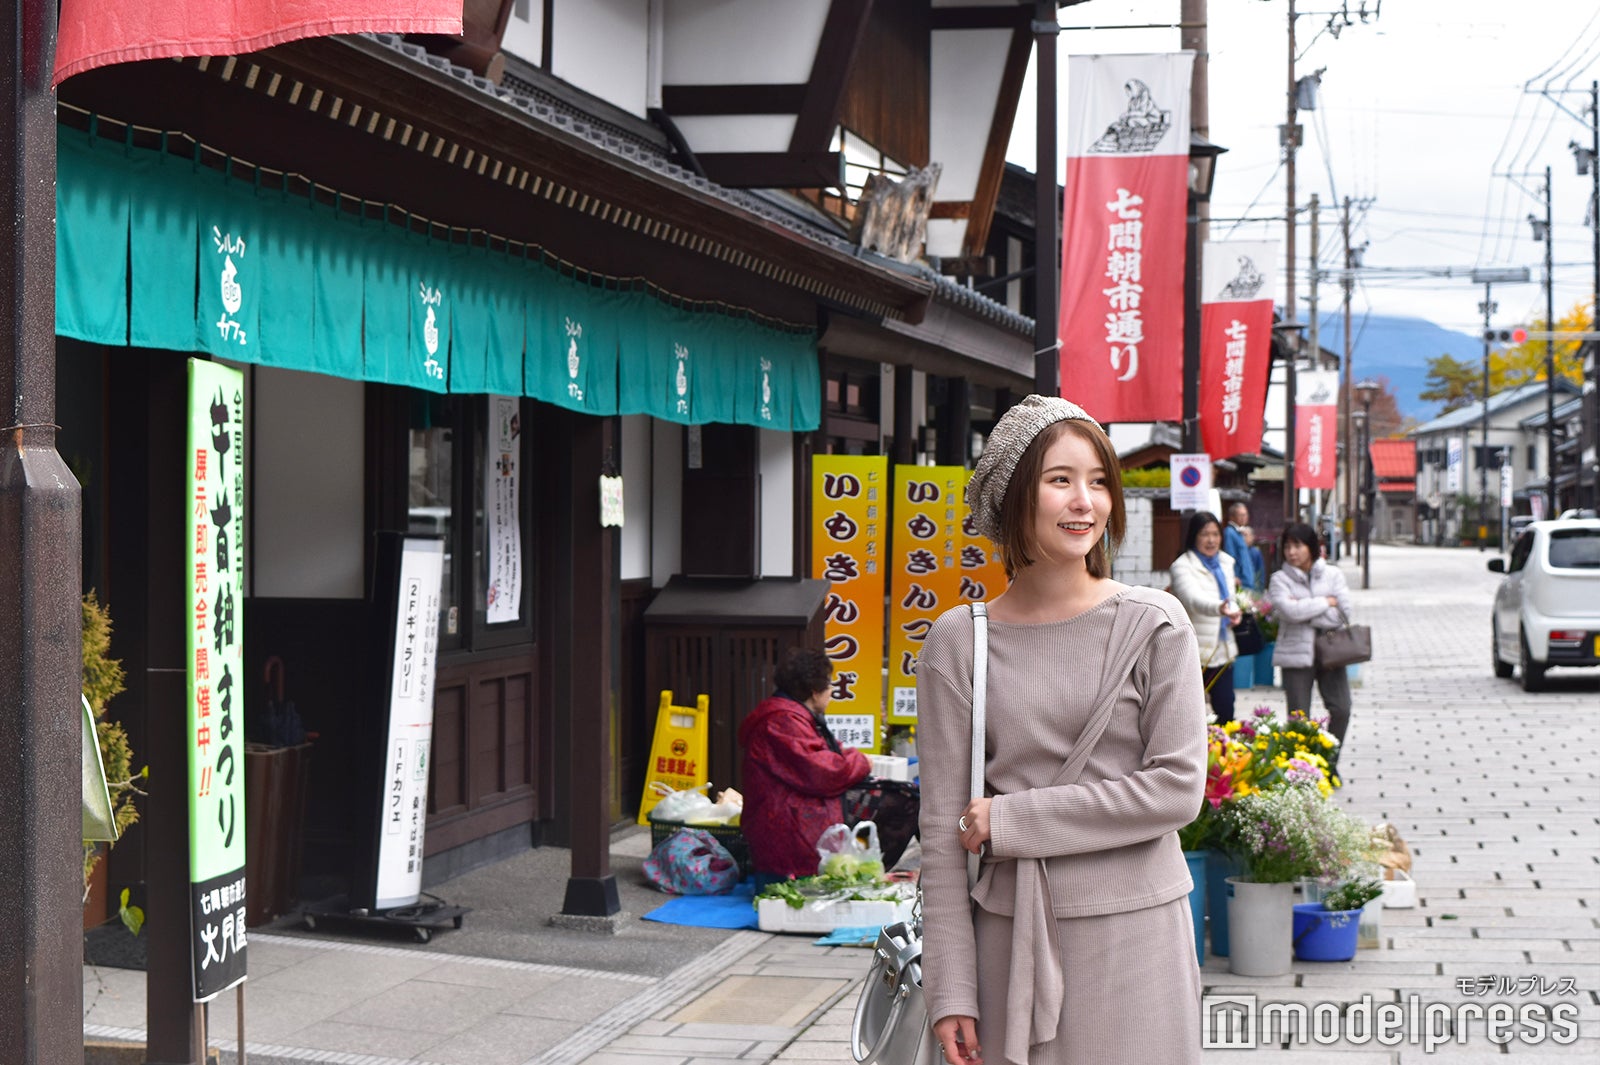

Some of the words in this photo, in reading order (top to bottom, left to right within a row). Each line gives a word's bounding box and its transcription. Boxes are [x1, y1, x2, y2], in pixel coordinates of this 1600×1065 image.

[213, 225, 246, 258] シルク
[420, 281, 442, 307] シルク
[1103, 188, 1144, 381] 七間朝市通り
[216, 312, 247, 345] カフェ
[423, 353, 444, 379] カフェ
[1222, 319, 1248, 435] 七間朝市通り
[823, 472, 862, 701] いもきんつば
[404, 584, 418, 692] 2Fギャラリー
[392, 747, 404, 822] 1Fカフェ
